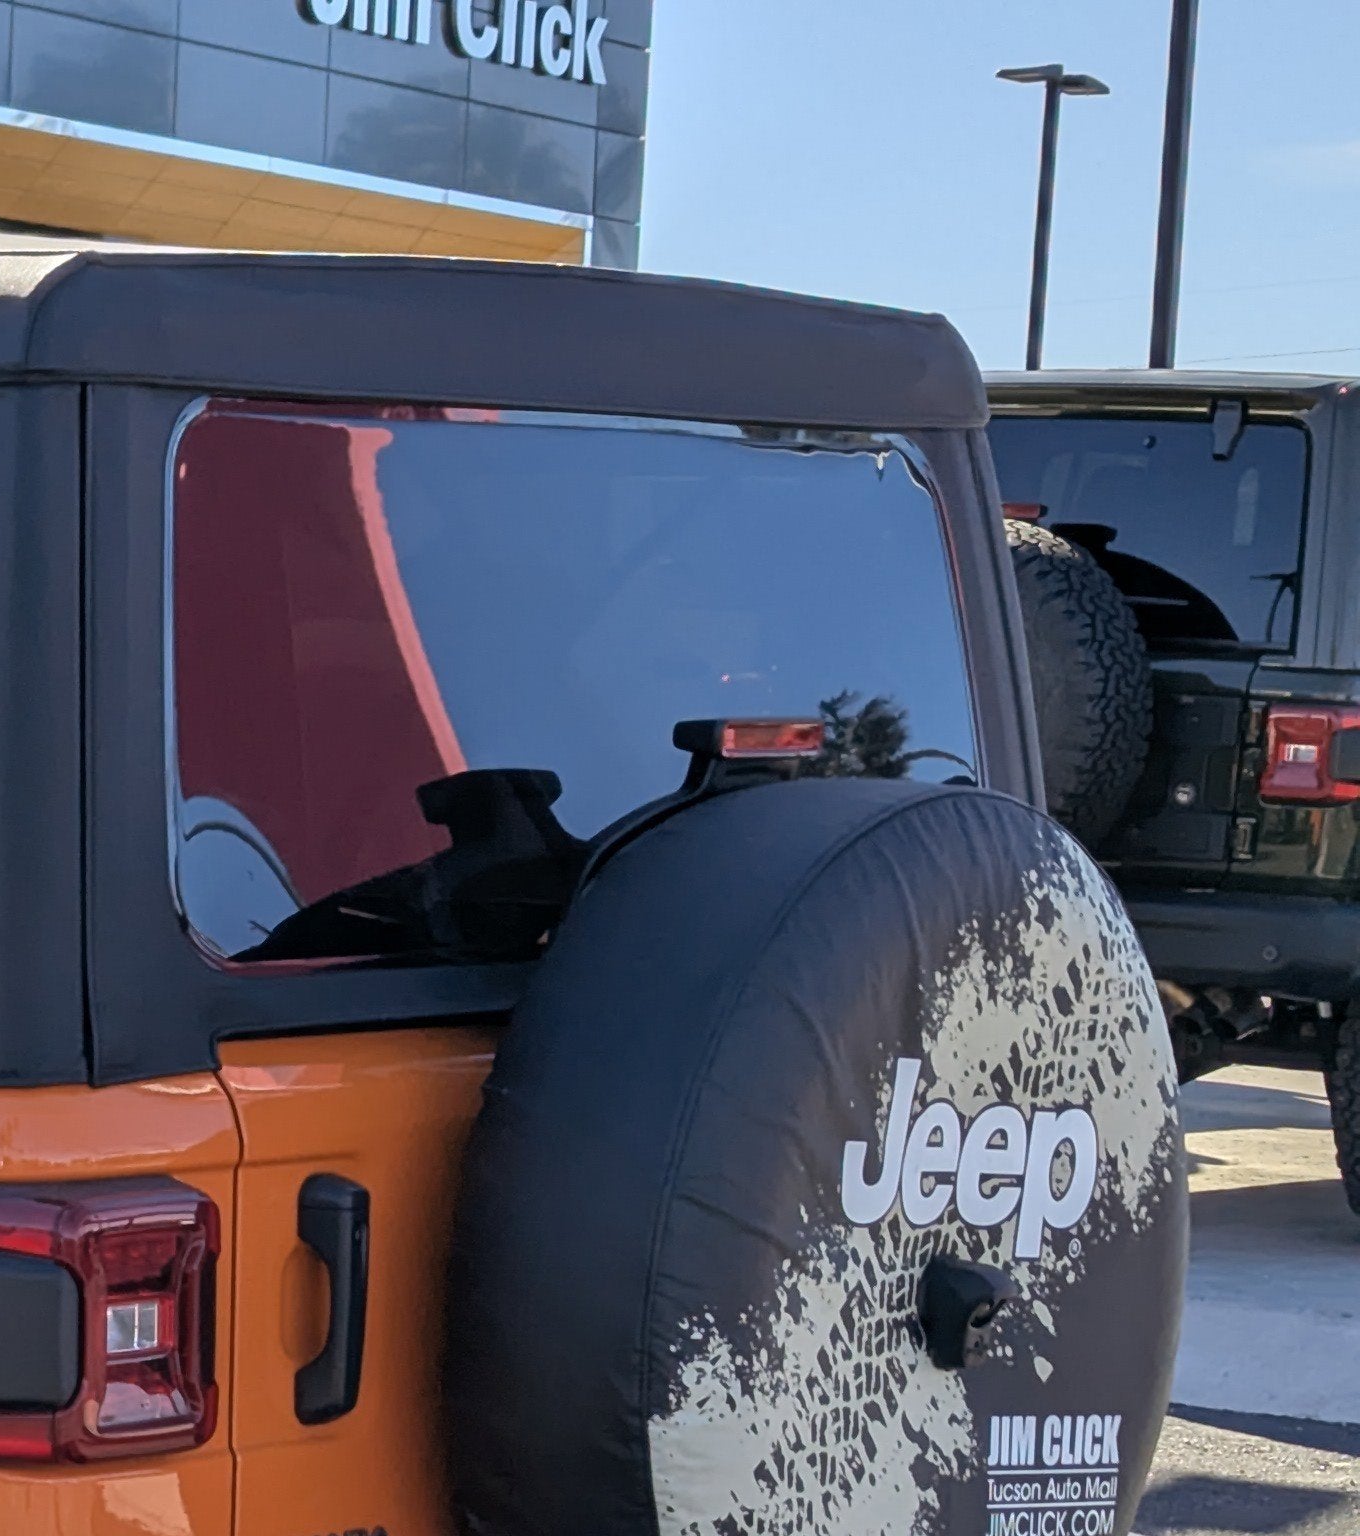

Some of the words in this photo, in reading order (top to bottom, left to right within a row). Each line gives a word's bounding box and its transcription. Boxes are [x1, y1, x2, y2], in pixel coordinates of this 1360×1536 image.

[841, 1057, 1098, 1260] Jeep
[987, 1415, 1037, 1467] JIM
[1042, 1413, 1123, 1467] CLICK
[986, 1477, 1042, 1502] Tucson
[1045, 1476, 1082, 1501] Auto
[1085, 1475, 1119, 1499] Mall
